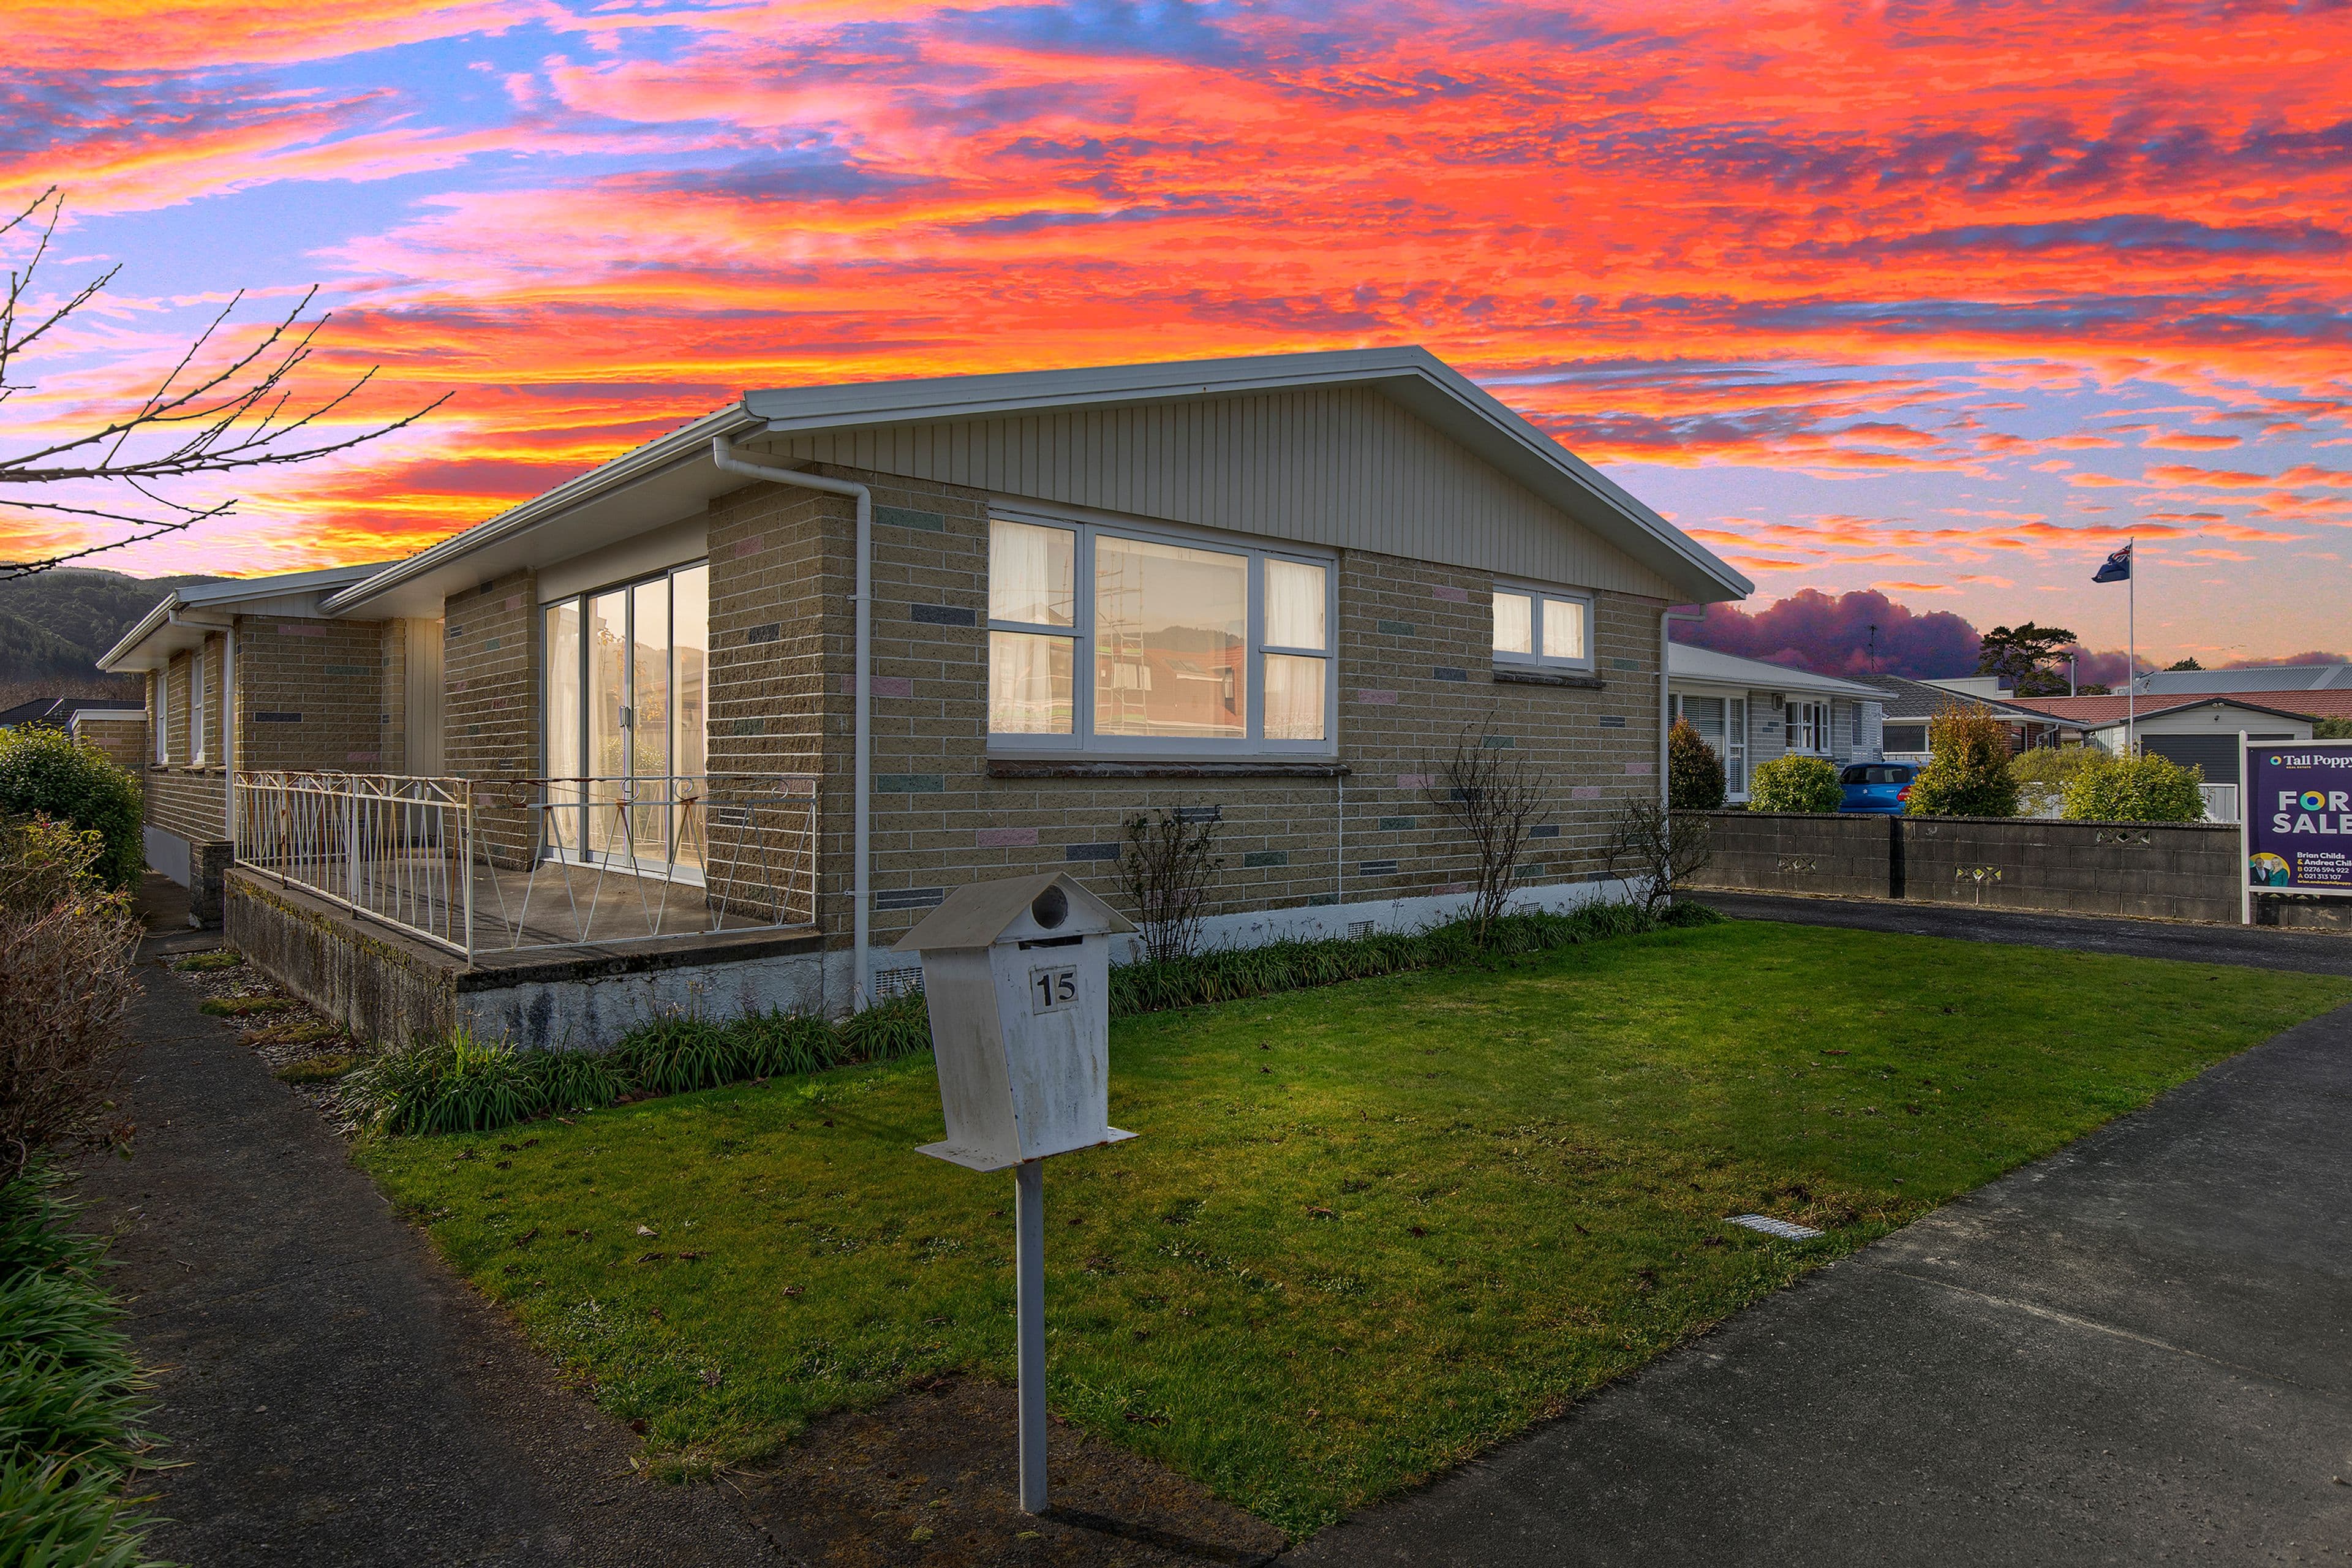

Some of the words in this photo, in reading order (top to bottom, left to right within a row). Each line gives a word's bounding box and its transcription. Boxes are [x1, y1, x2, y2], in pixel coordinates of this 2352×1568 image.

[2283, 755, 2311, 765] Tall
[2279, 791, 2350, 812] FOR
[2272, 813, 2352, 834] SALE
[1037, 972, 1076, 1006] 15
